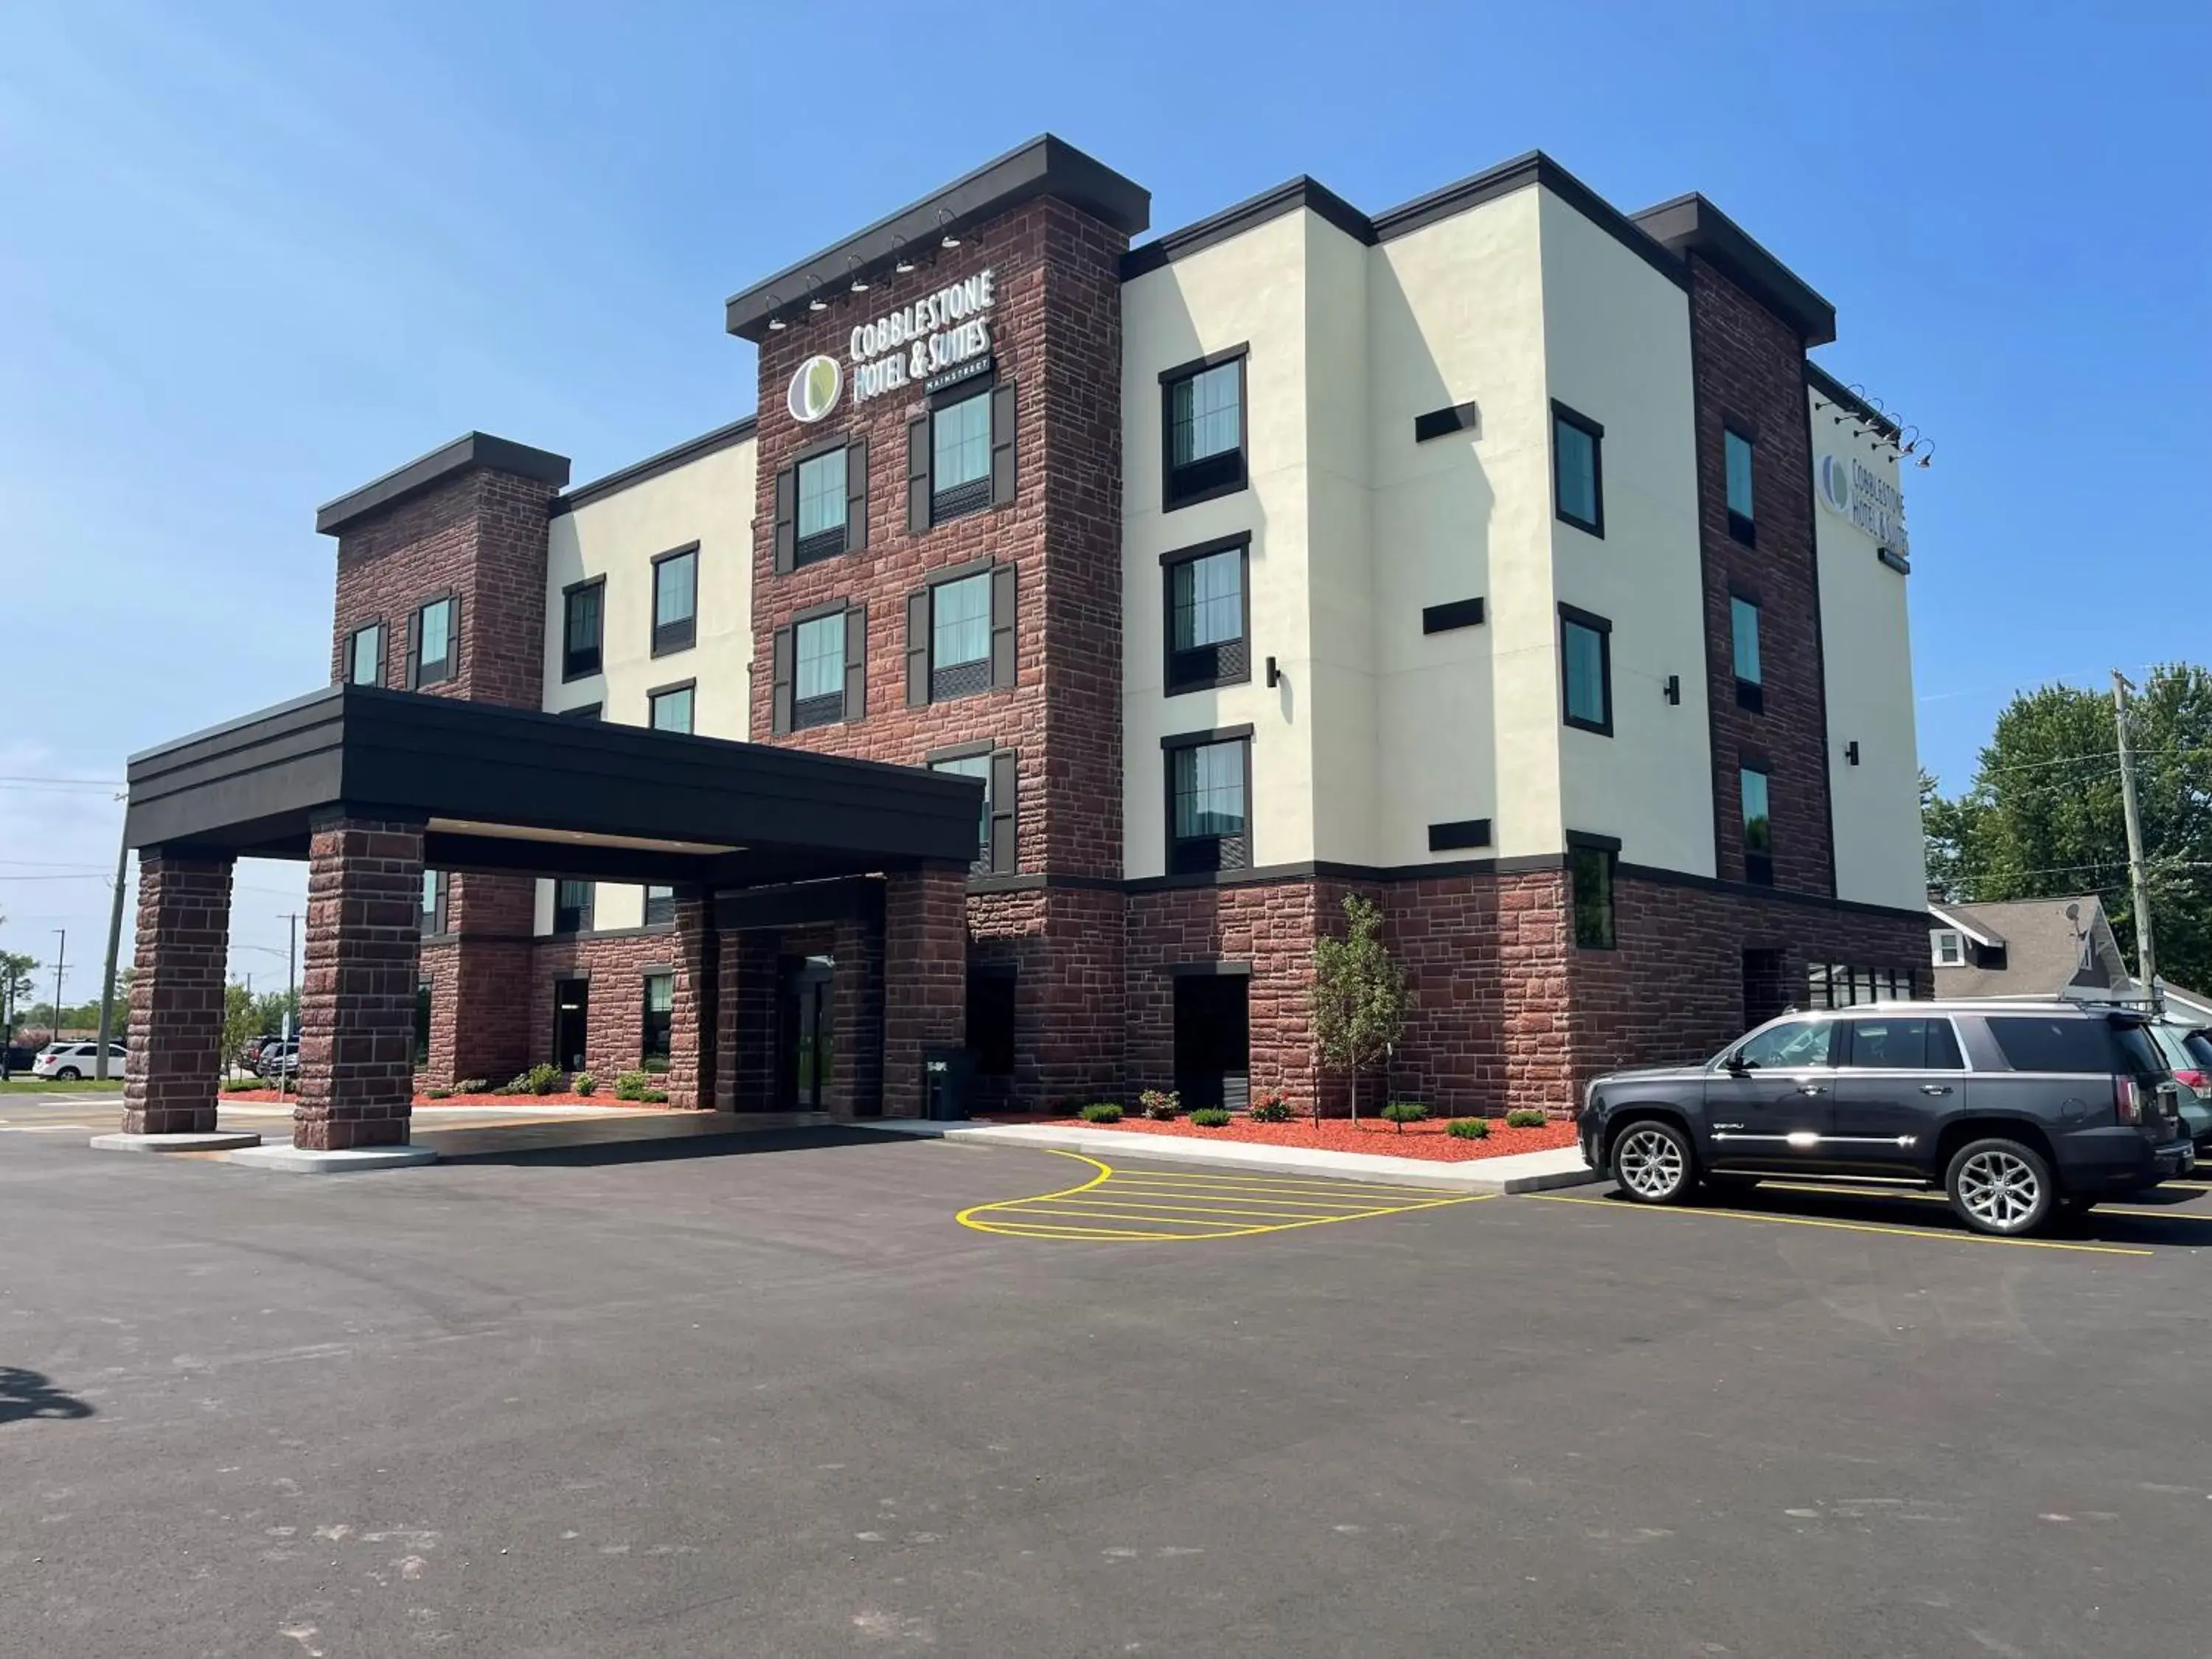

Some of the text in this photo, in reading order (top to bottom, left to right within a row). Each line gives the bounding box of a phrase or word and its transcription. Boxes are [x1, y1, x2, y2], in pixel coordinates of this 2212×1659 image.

[851, 269, 995, 362] COBBLESTONE
[854, 316, 991, 403] HOTEL & SUITES
